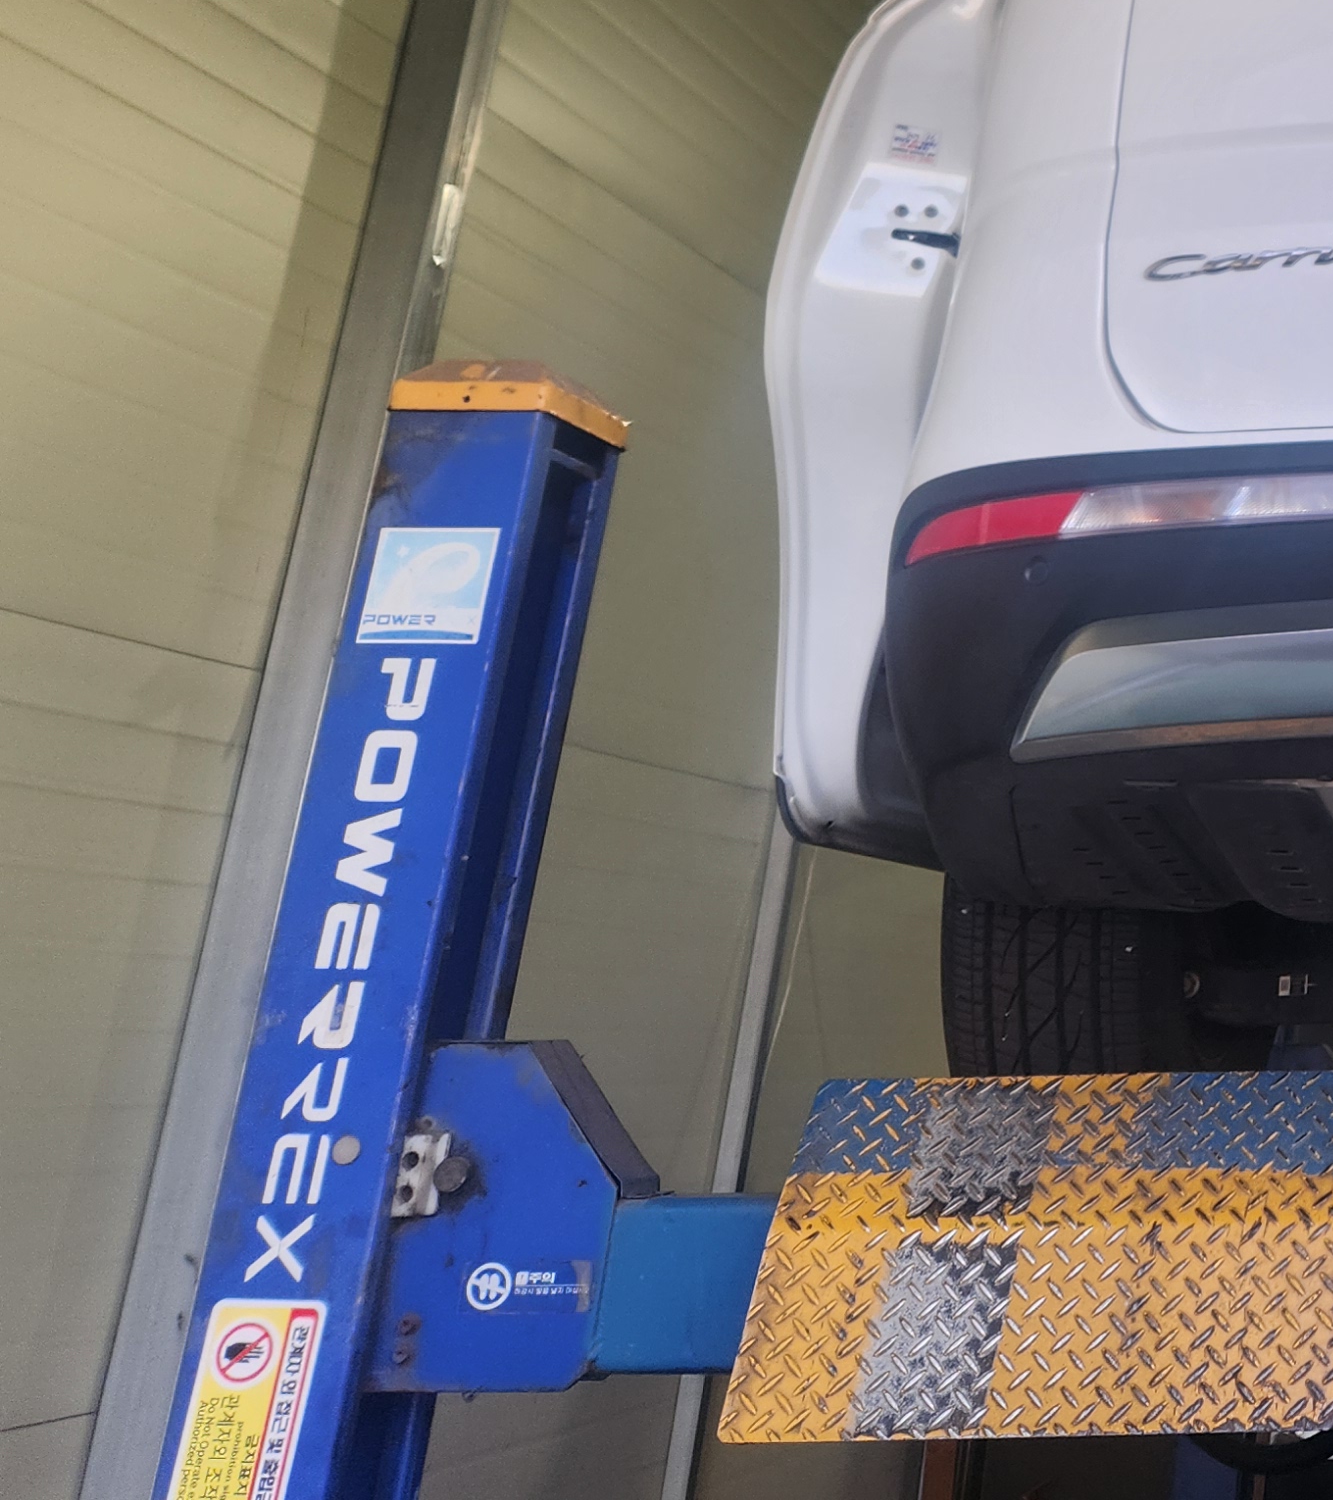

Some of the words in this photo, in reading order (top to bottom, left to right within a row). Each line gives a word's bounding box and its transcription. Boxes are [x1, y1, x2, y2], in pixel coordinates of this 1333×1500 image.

[243, 657, 437, 1283] POWERREX
[529, 1272, 556, 1284] 주의
[286, 1325, 310, 1376] 관계자
[280, 1380, 298, 1396] 외
[208, 1397, 220, 1414] Do
[271, 1400, 292, 1434] 접근
[185, 1401, 208, 1466] Authorized
[201, 1417, 215, 1438] Not
[224, 1421, 245, 1483] prohibition
[266, 1438, 284, 1454] 및
[189, 1440, 209, 1489] Operate
